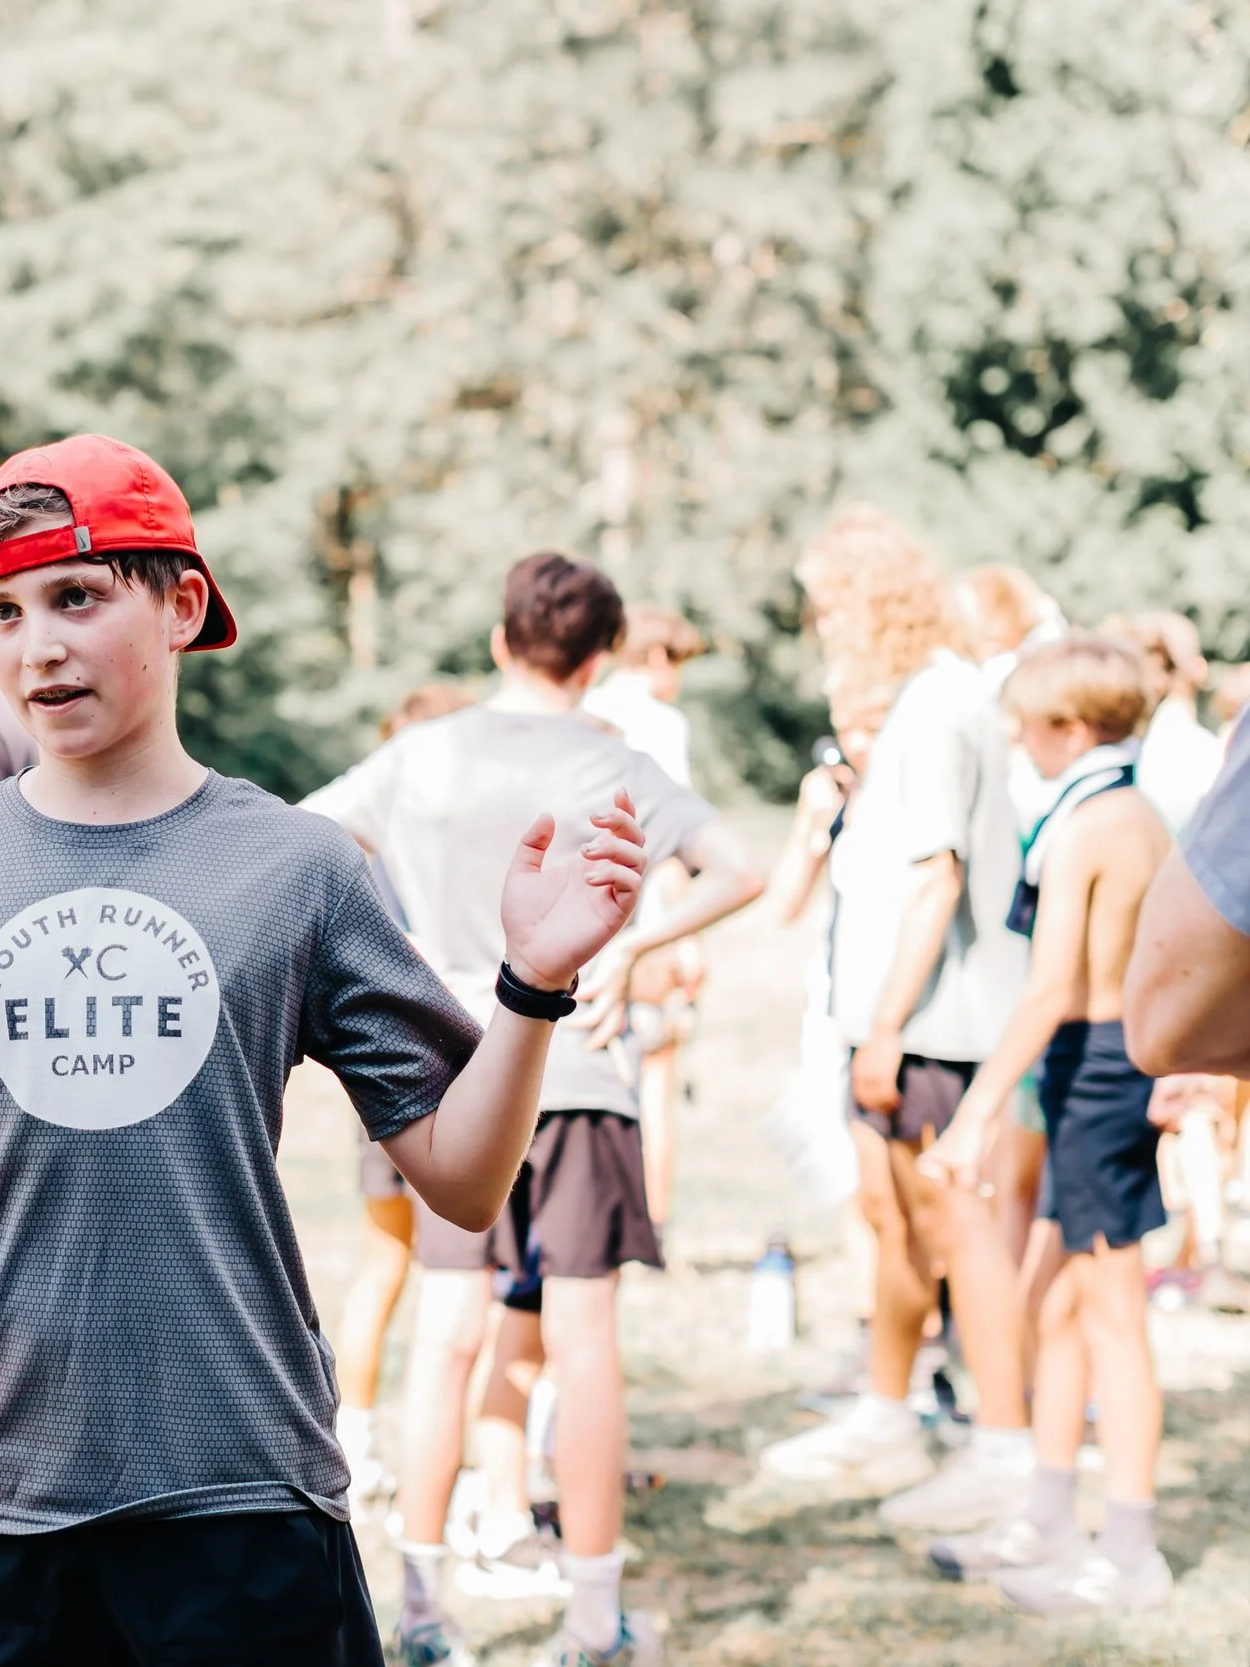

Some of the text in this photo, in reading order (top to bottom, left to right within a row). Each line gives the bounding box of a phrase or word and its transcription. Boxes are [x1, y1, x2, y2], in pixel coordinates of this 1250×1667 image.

[61, 944, 128, 981] XC
[99, 904, 210, 991] RUNNER
[5, 996, 182, 1041] ELITE
[51, 1054, 135, 1076] CAMP
